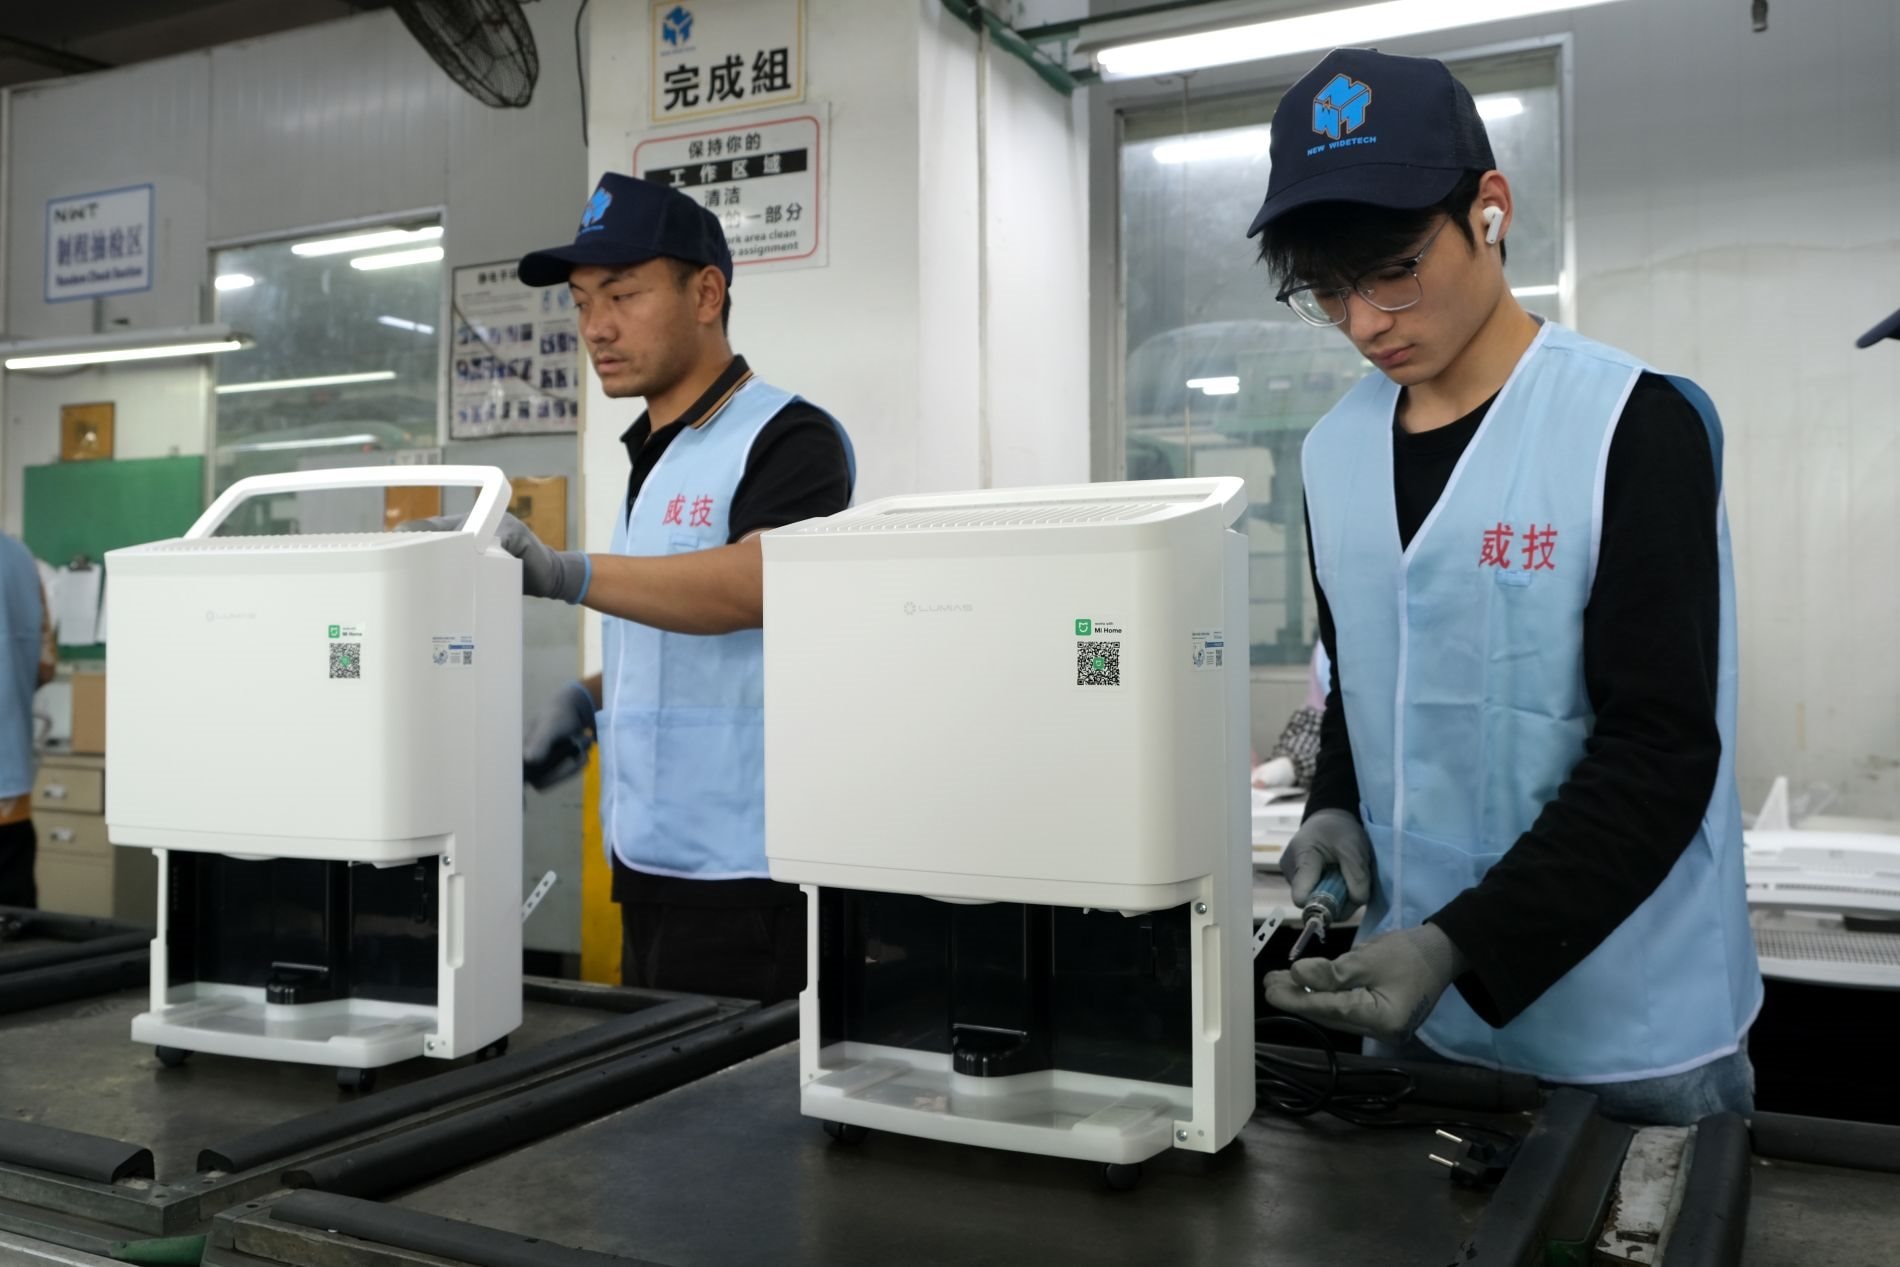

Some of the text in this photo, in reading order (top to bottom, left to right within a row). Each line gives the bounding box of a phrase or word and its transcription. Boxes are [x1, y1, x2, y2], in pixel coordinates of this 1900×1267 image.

[664, 47, 792, 111] 完成組
[688, 132, 761, 159] 保持你的
[1307, 136, 1377, 156] NEW WIDETECH
[669, 154, 782, 188] 工作区域
[704, 186, 741, 208] 清洁
[744, 233, 766, 242] area
[768, 229, 797, 240] clean
[738, 241, 799, 256] assignment
